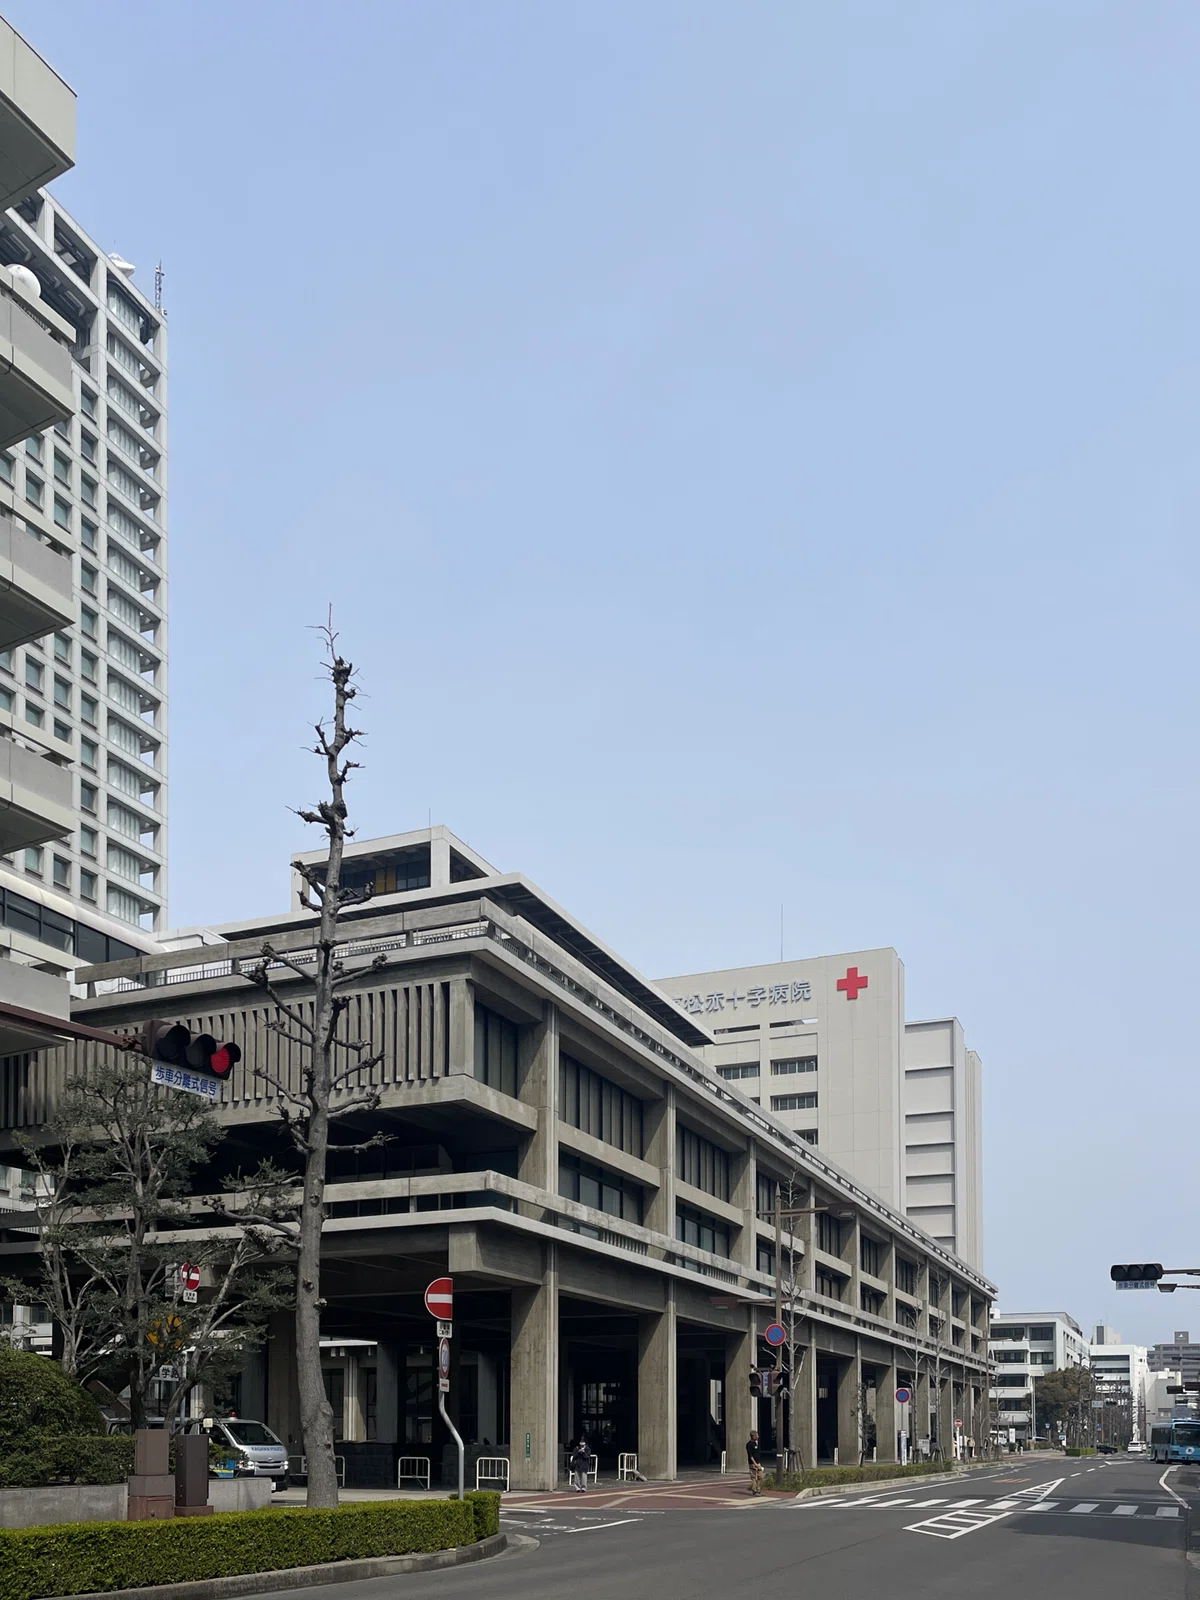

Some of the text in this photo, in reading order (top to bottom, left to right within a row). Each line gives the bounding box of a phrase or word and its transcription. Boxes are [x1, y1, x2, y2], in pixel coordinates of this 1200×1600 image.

[672, 980, 812, 1014] 松赤十字病院
[155, 1066, 217, 1096] 歩車分離式信号
